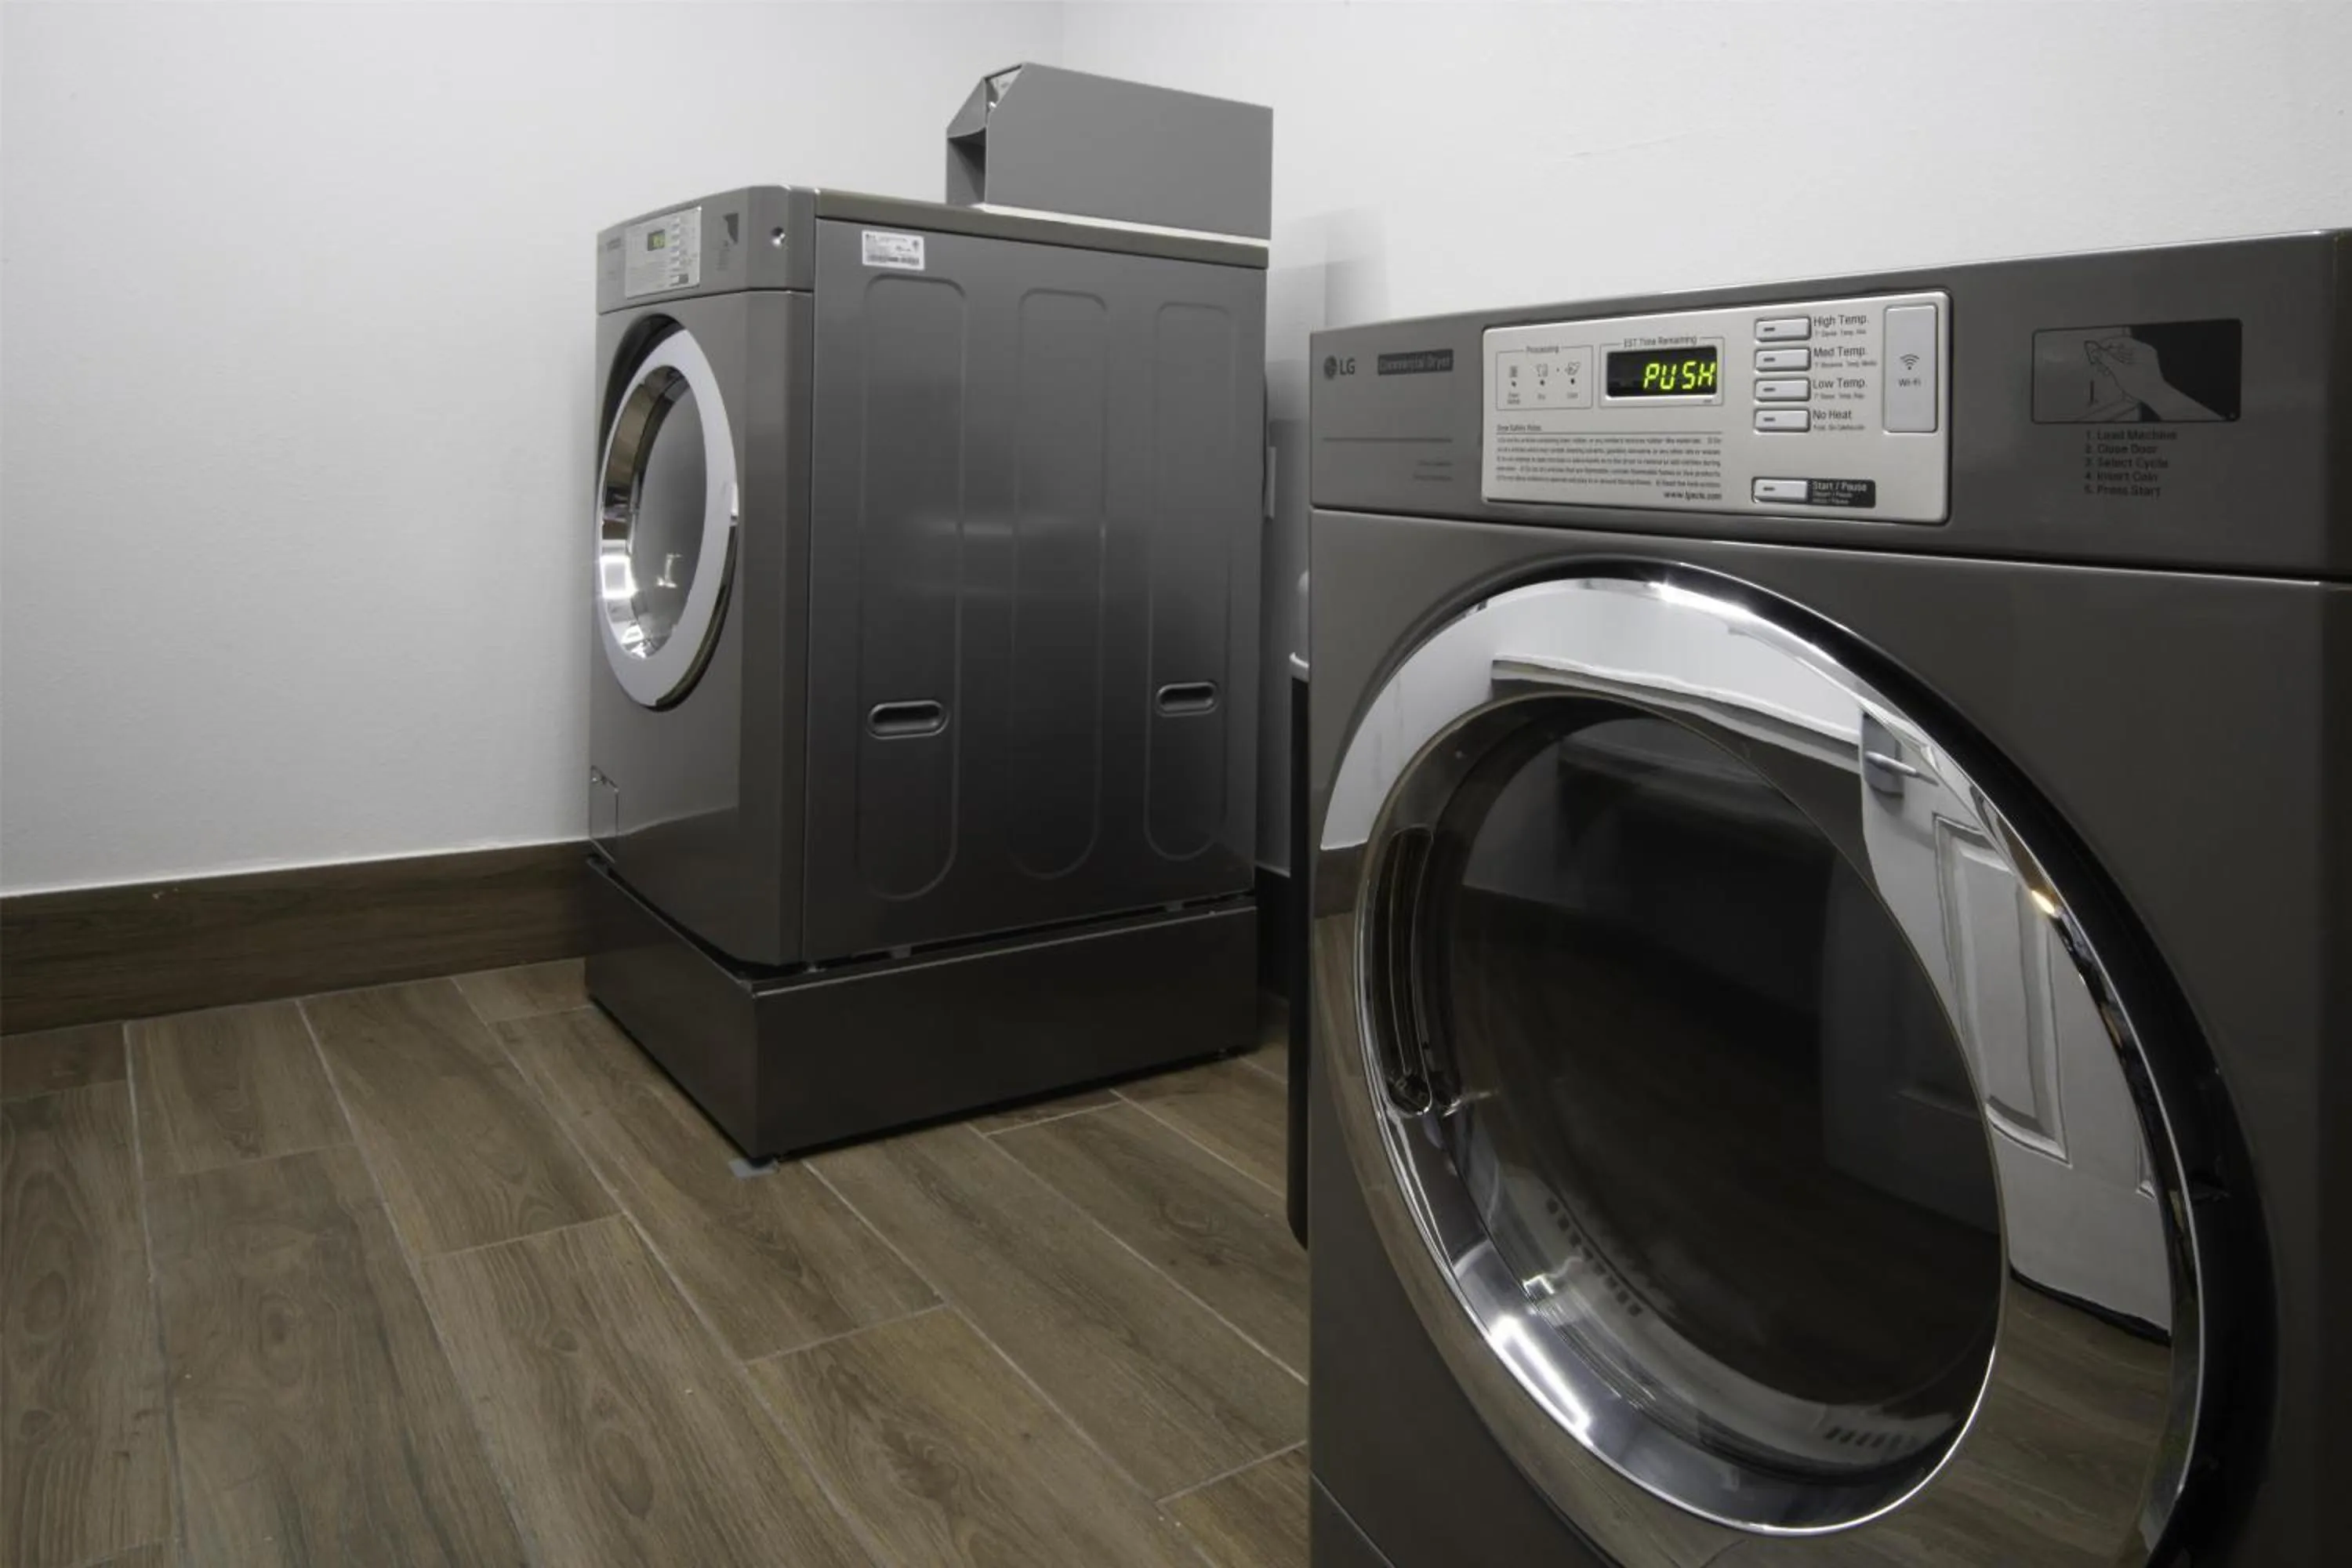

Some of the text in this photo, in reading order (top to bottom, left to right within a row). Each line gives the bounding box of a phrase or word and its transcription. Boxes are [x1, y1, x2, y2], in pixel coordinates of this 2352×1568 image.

[1813, 314, 1869, 328] High Temp.
[1813, 347, 1867, 358] Med Temp.
[1339, 358, 1356, 376] LG
[1643, 361, 1716, 390] PUSH
[1813, 377, 1867, 390] Low Temp.
[1813, 409, 1852, 420] No Heat
[2130, 443, 2158, 454] Door
[1812, 481, 1834, 491] Start
[1841, 481, 1867, 492] Pause
